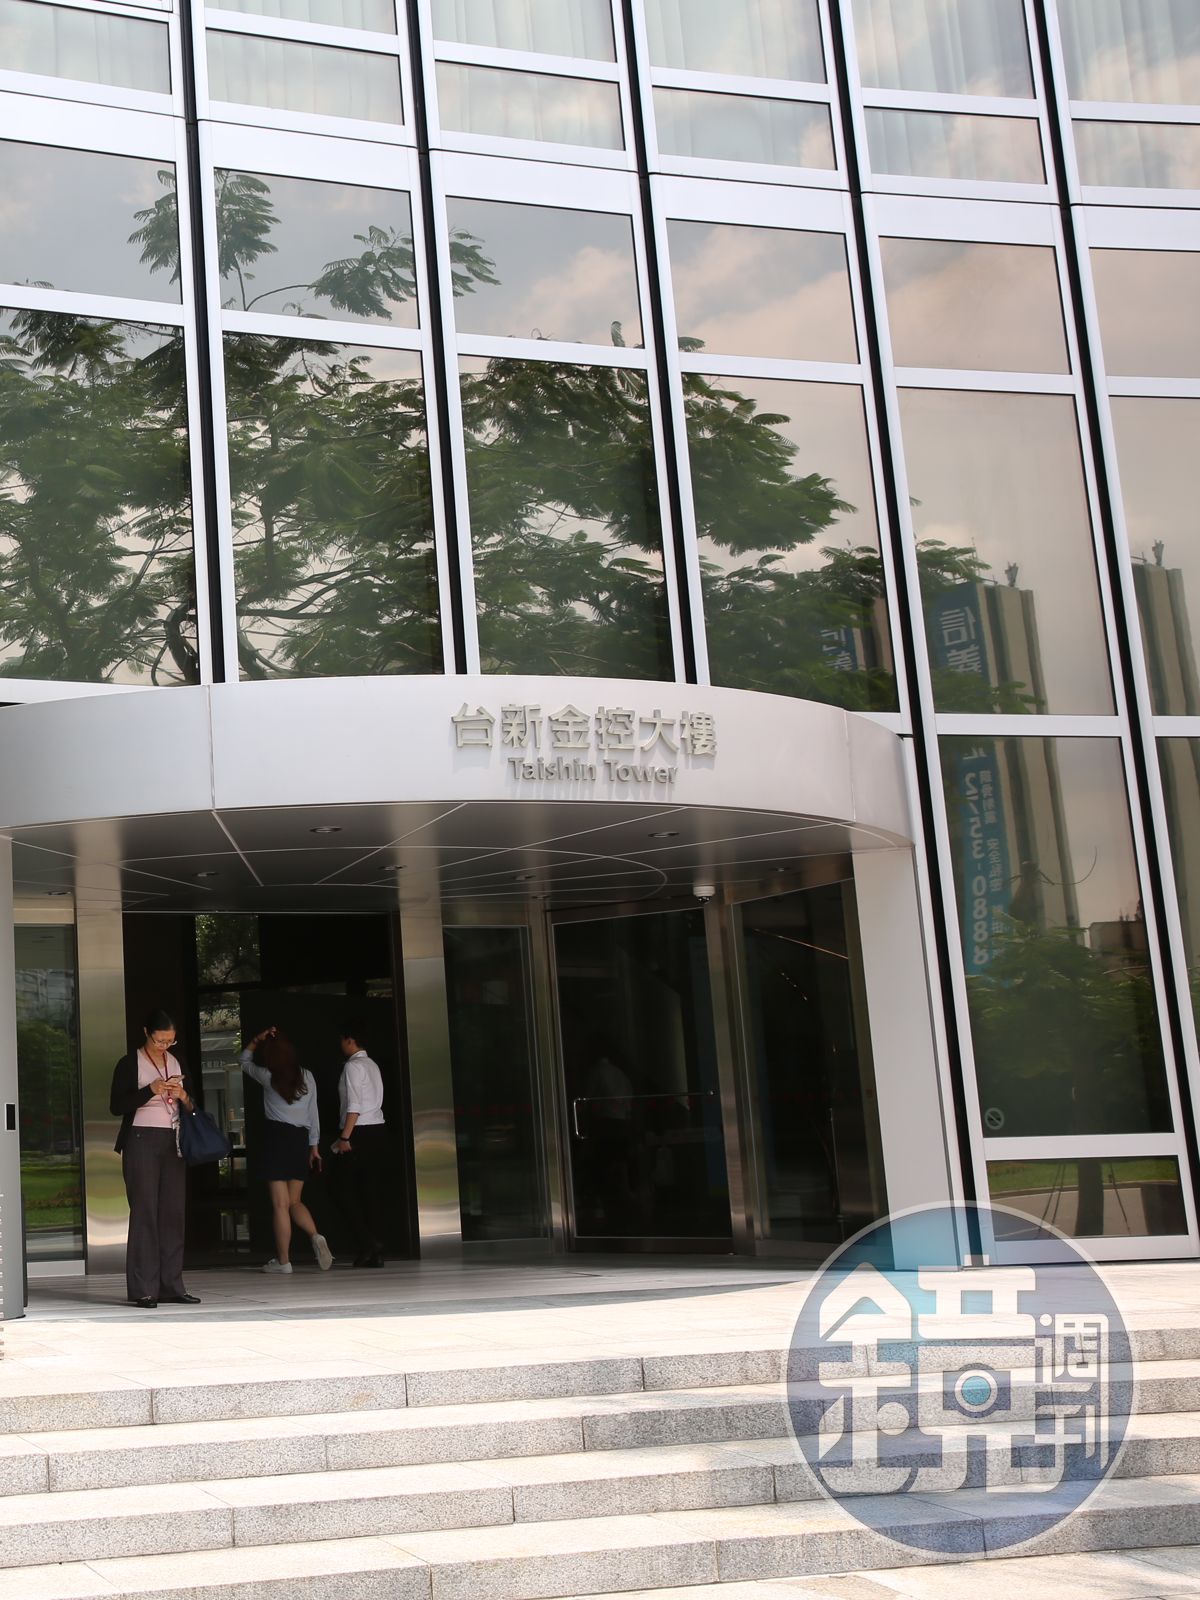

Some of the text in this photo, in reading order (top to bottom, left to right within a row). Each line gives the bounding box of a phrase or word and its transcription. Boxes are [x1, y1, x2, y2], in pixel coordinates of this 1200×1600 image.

[451, 703, 717, 756] 台新金控大樓
[508, 756, 678, 784] Taishin Tower
